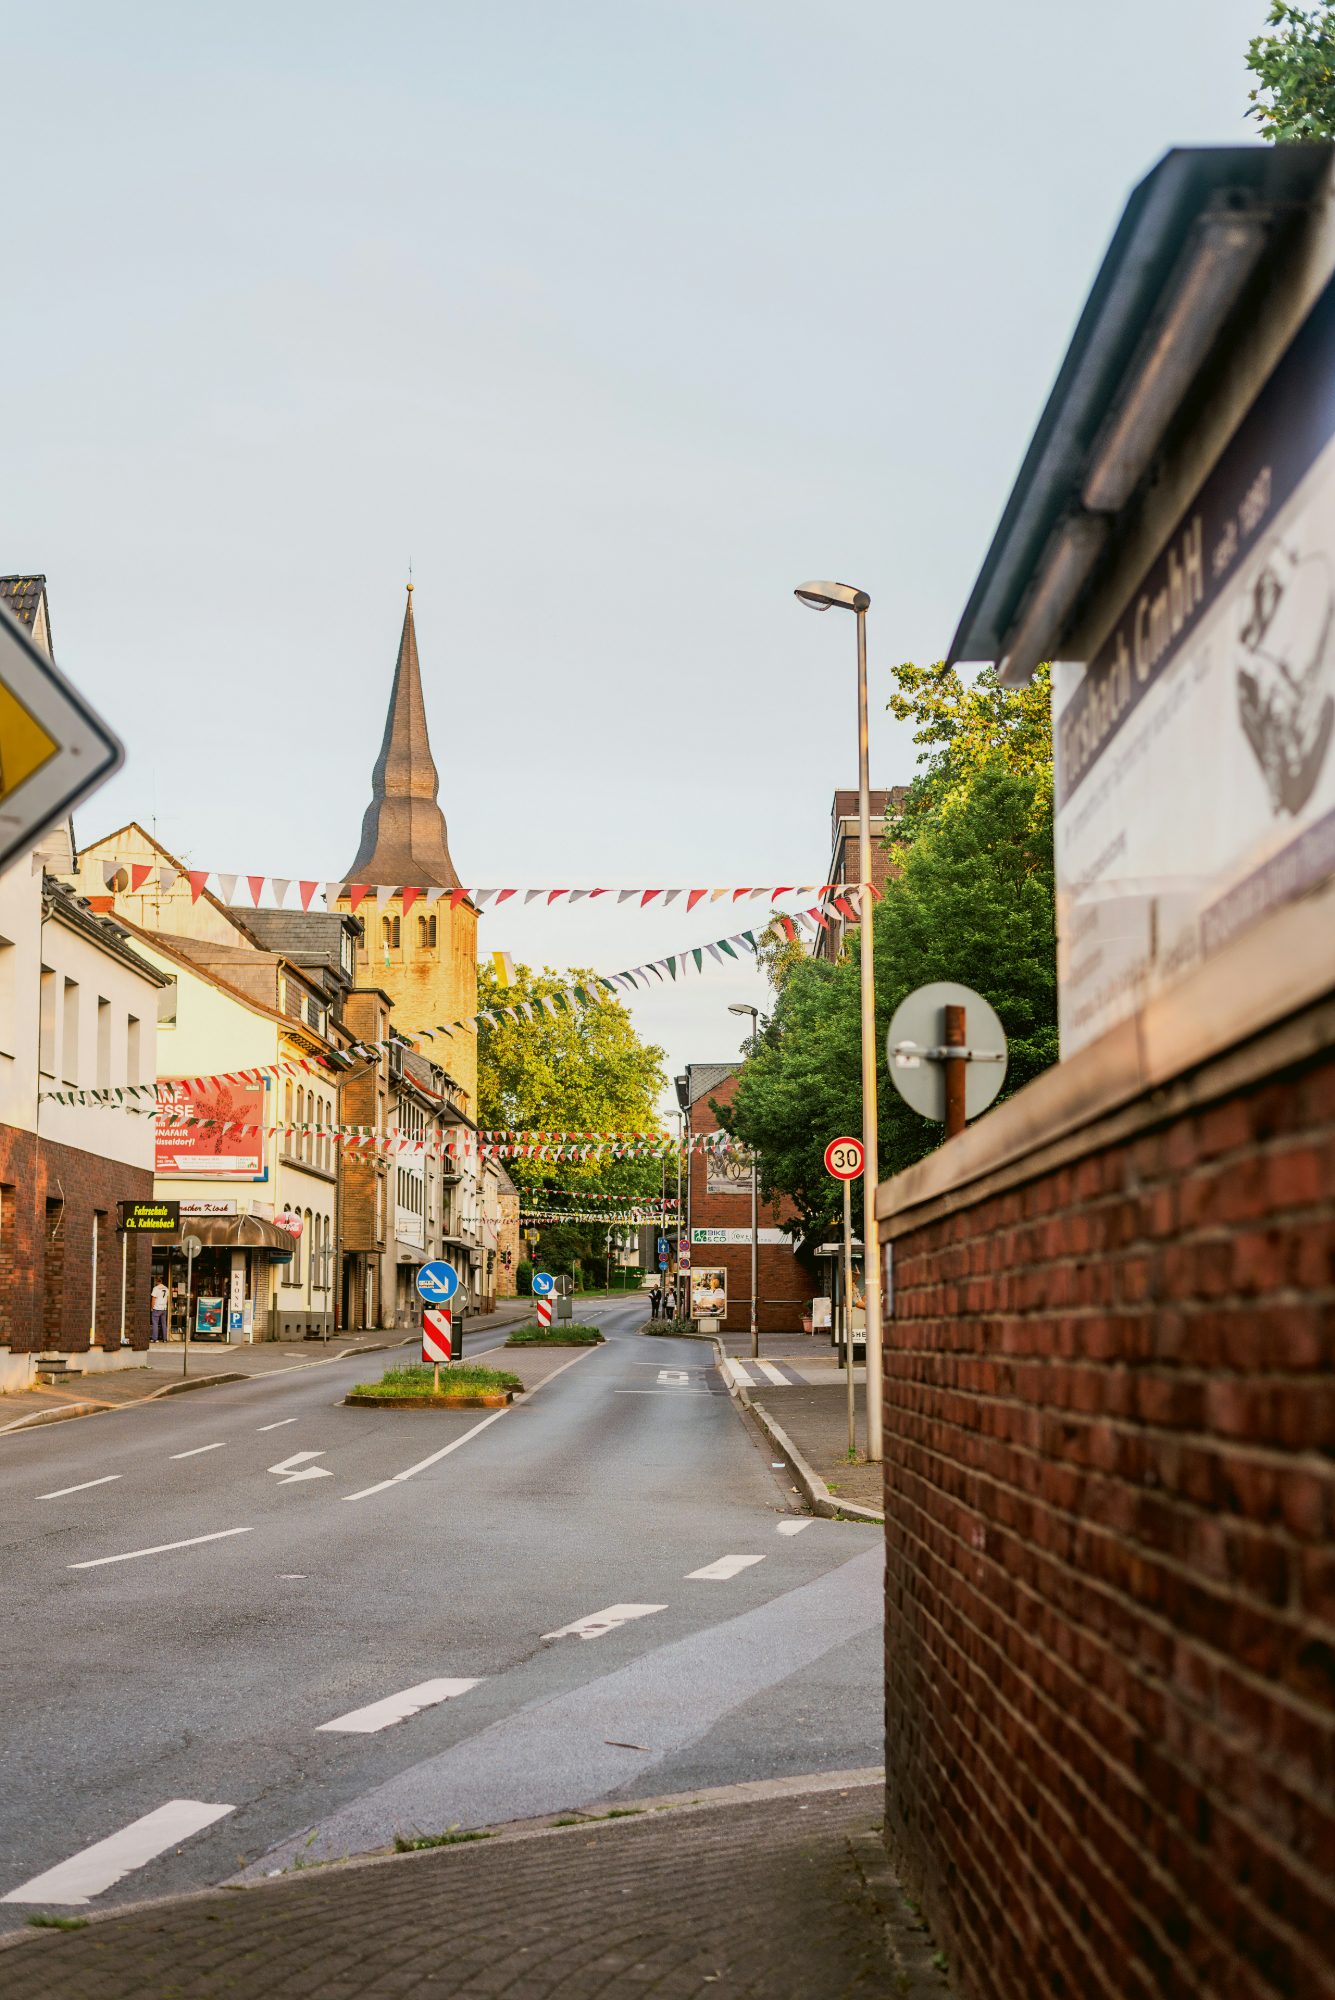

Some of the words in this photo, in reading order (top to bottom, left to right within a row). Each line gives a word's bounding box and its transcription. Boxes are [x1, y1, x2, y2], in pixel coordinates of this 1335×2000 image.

[1134, 514, 1204, 684] GmbH
[834, 1149, 858, 1168] 30
[134, 1205, 168, 1216] Fahrschule
[204, 1203, 229, 1212] Kiosk
[126, 1218, 137, 1228] Ch.
